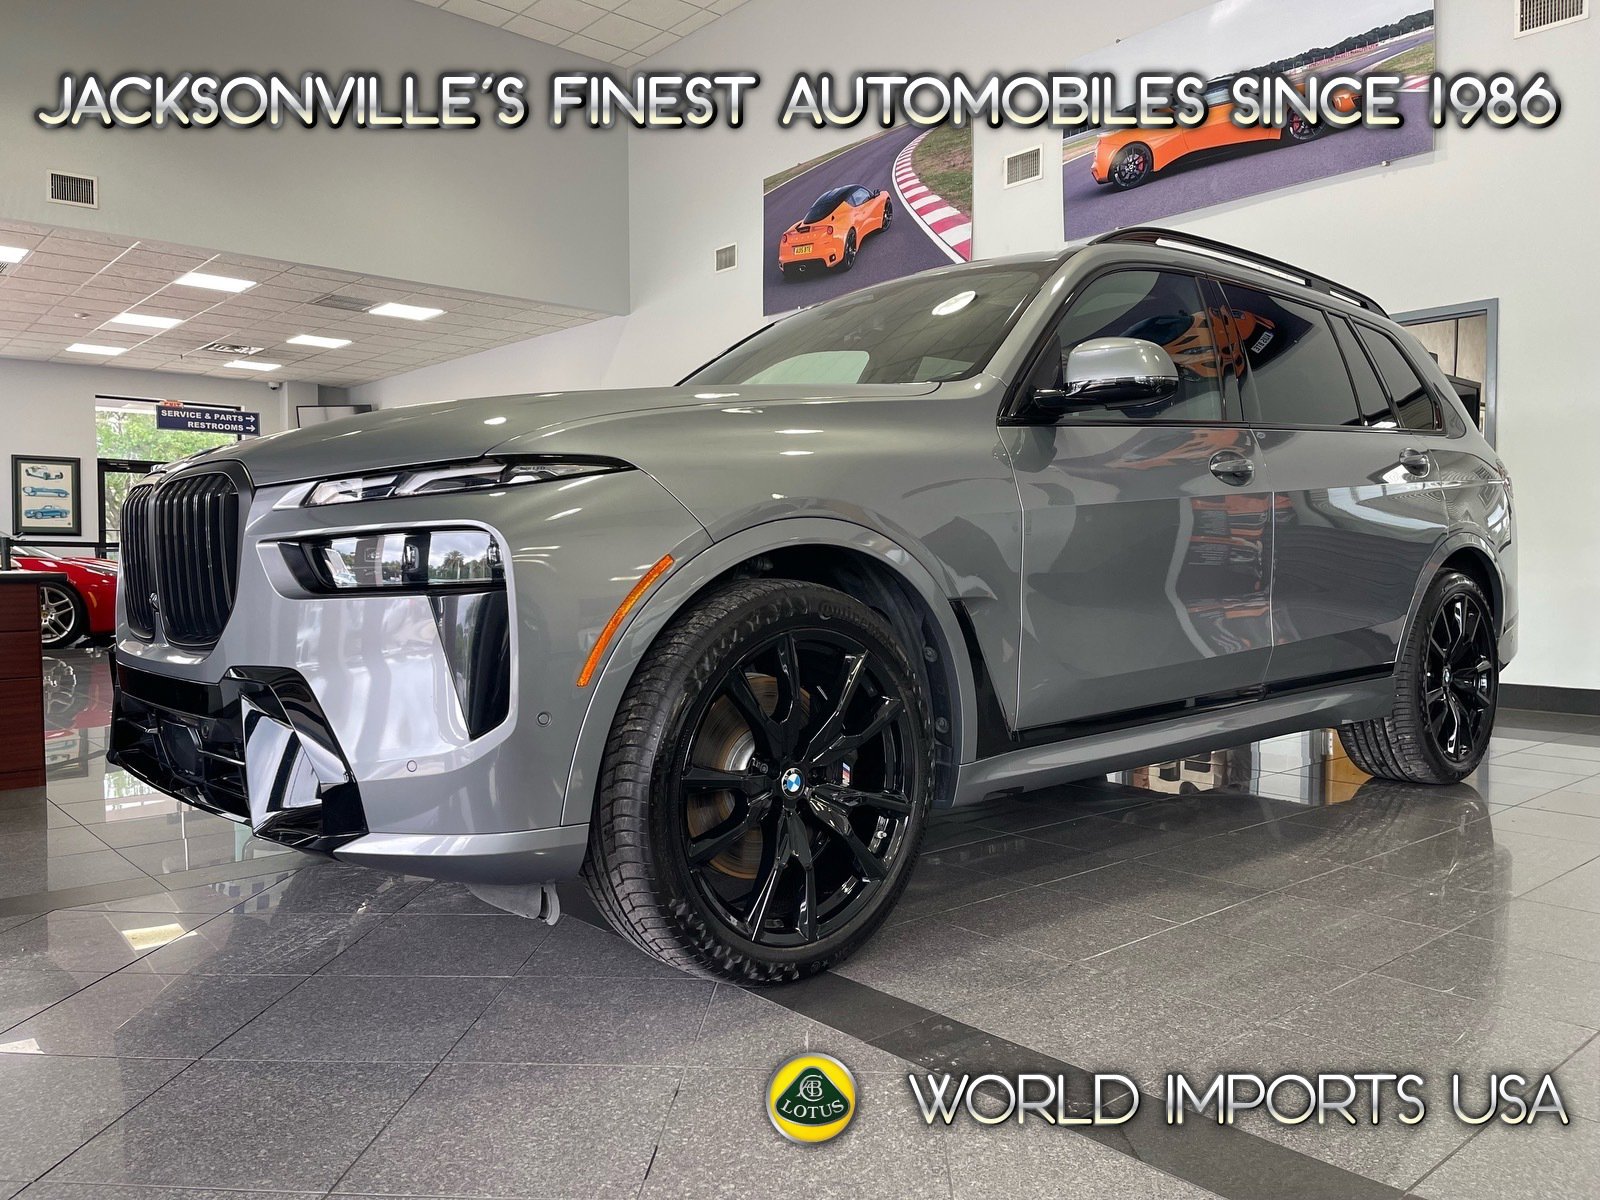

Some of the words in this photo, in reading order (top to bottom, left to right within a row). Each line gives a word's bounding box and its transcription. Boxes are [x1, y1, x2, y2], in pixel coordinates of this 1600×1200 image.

[161, 409, 202, 419] SERVICE
[204, 412, 212, 420] &
[214, 414, 244, 422] PARTS
[187, 421, 244, 431] RESTROOMS
